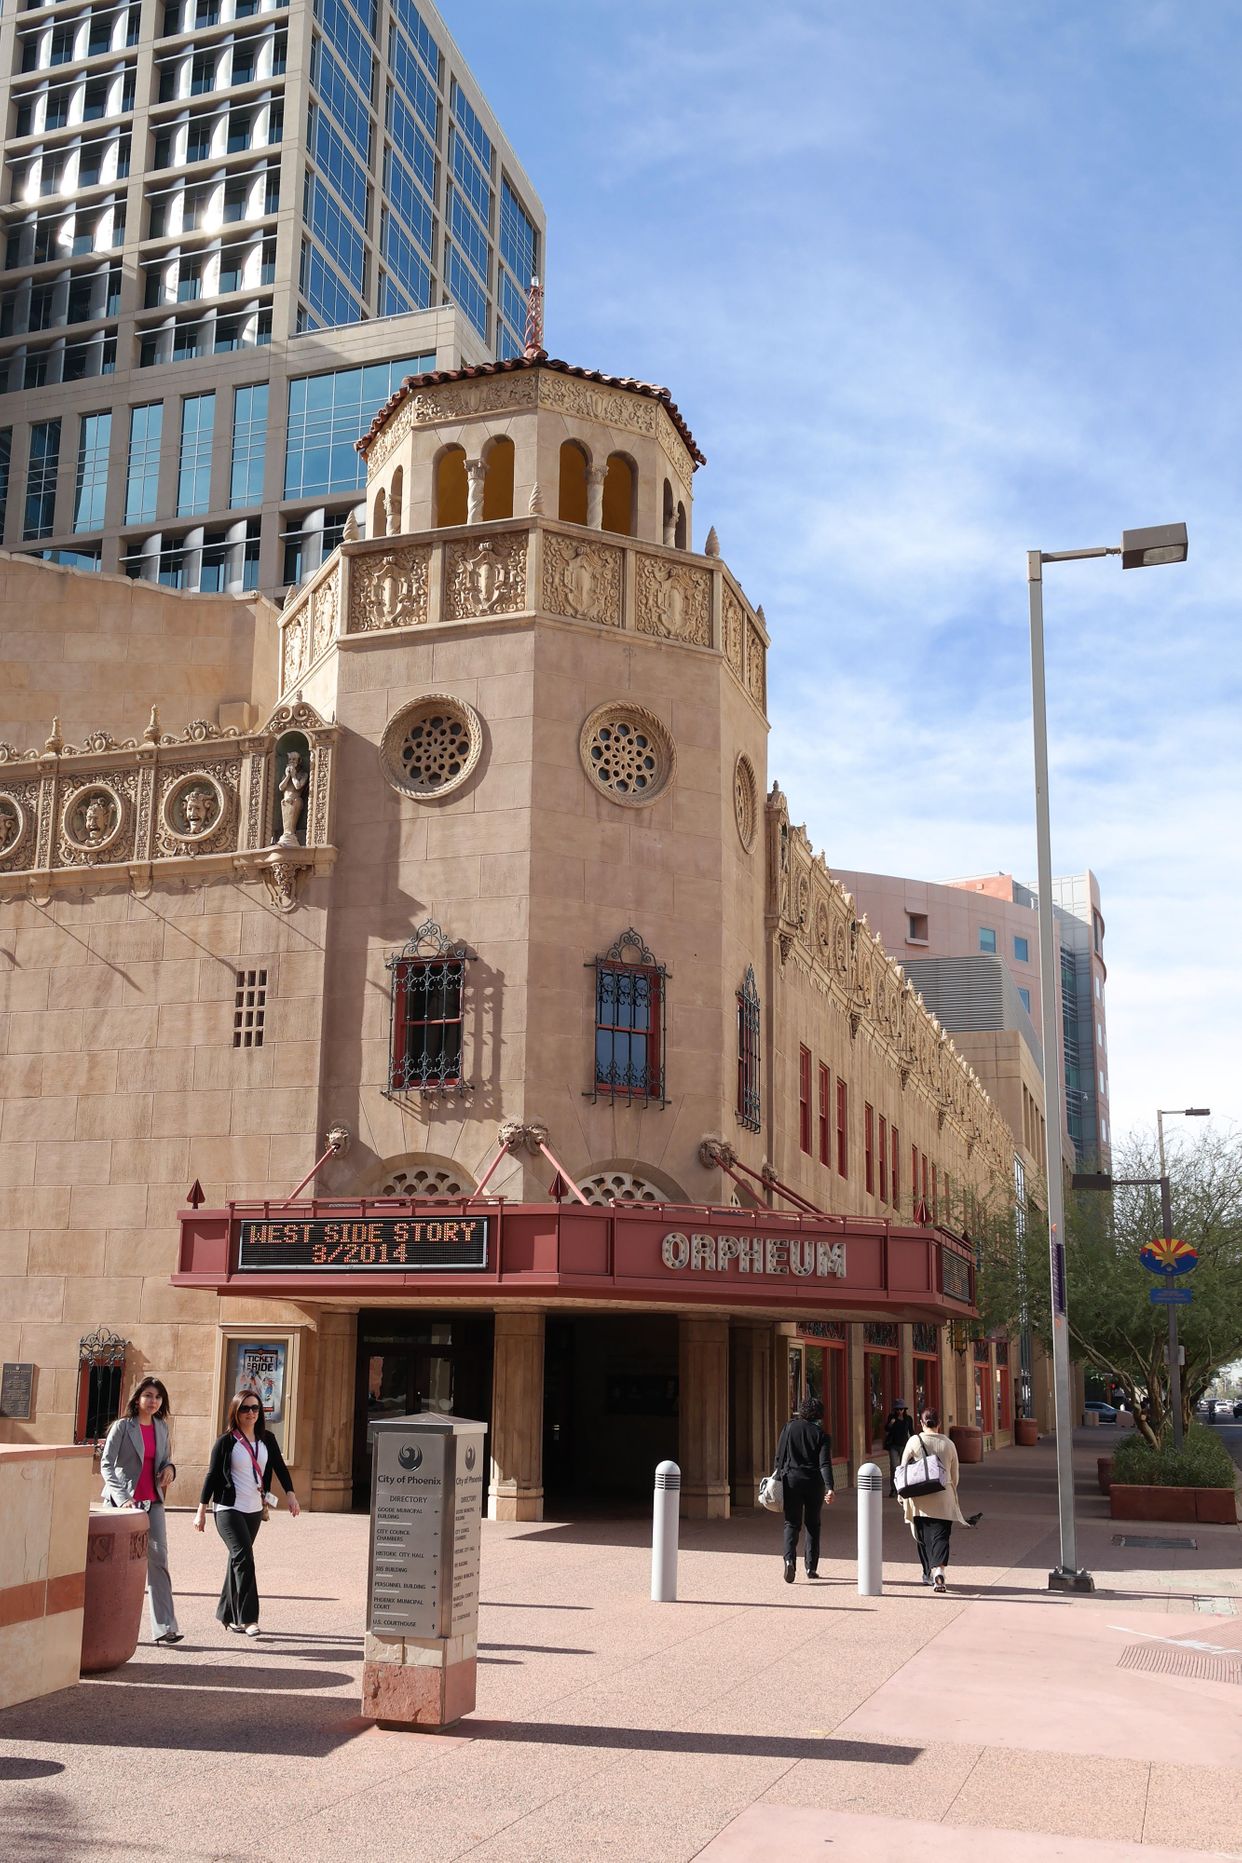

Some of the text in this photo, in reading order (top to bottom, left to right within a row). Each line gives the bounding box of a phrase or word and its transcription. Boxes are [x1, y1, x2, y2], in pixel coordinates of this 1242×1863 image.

[250, 1221, 477, 1243] WEST SIDE STORY
[312, 1243, 409, 1264] 3/2014
[661, 1231, 847, 1279] ORPHEUM
[247, 1355, 274, 1363] TICKET
[252, 1362, 274, 1372] RIDE
[377, 1475, 442, 1486] City of Phoenix
[389, 1495, 428, 1503] DIRECTORY
[375, 1550, 397, 1558] HISTORIC
[398, 1551, 411, 1559] CITY
[374, 1581, 402, 1589] PERSONNEL
[373, 1596, 424, 1606] PHOENIX MUNICIPAL
[383, 1619, 417, 1628] COURTHOUSE
